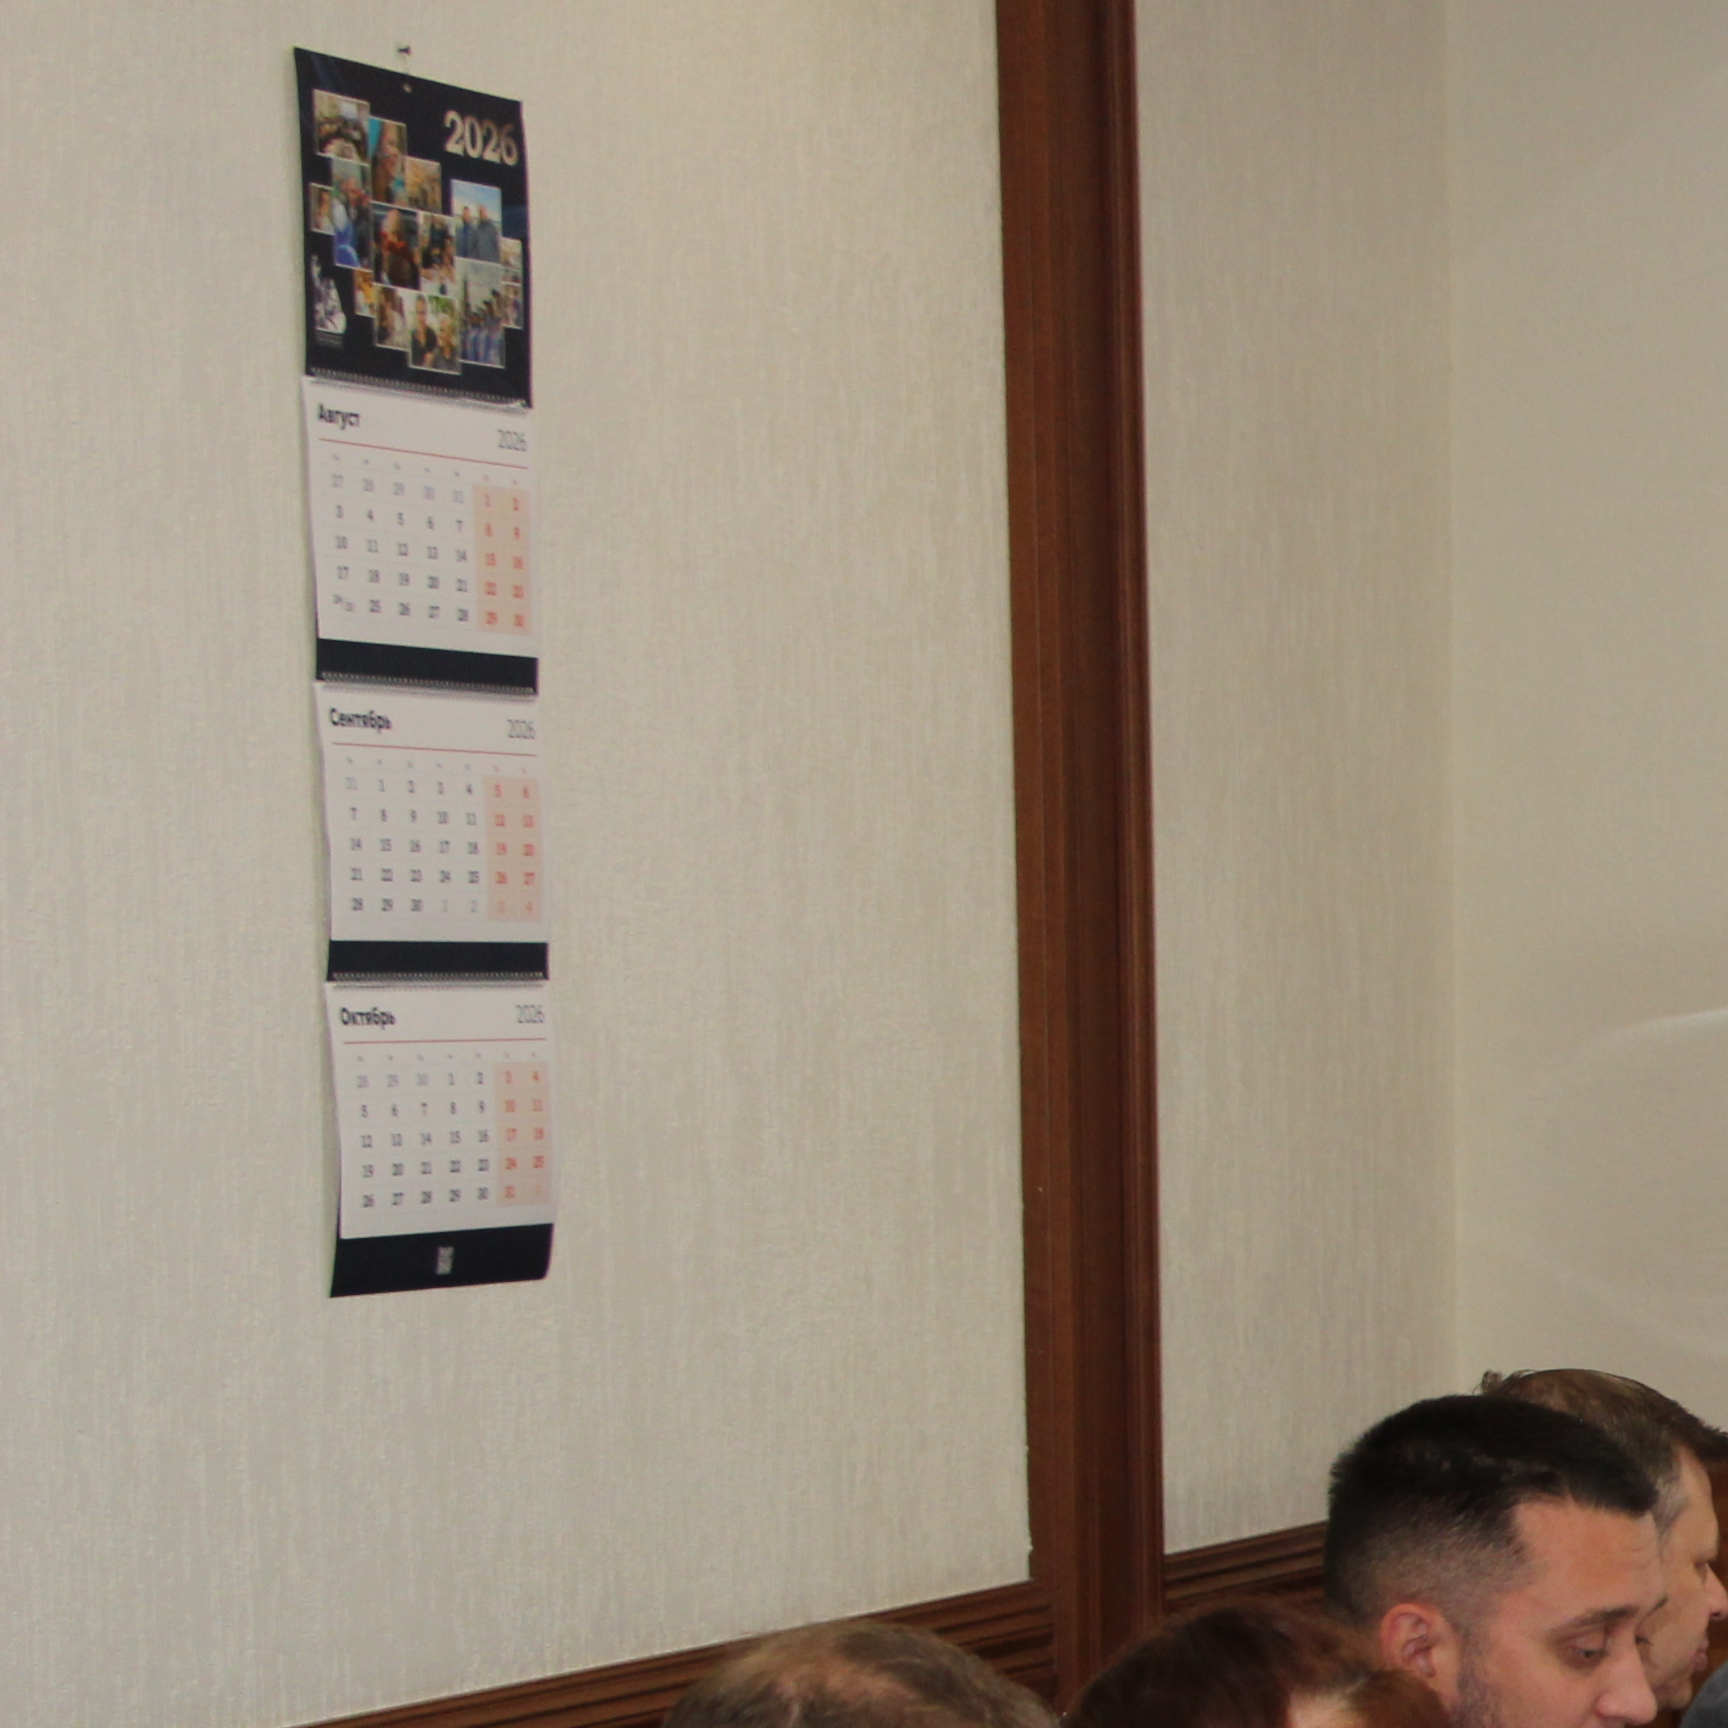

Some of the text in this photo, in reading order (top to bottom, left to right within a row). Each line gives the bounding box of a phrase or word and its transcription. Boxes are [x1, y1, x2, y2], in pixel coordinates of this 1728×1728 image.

[445, 110, 519, 165] 2026
[317, 403, 361, 430] Август
[329, 707, 392, 734] Сентябрь
[340, 1004, 545, 1030] Октябрь 2026
